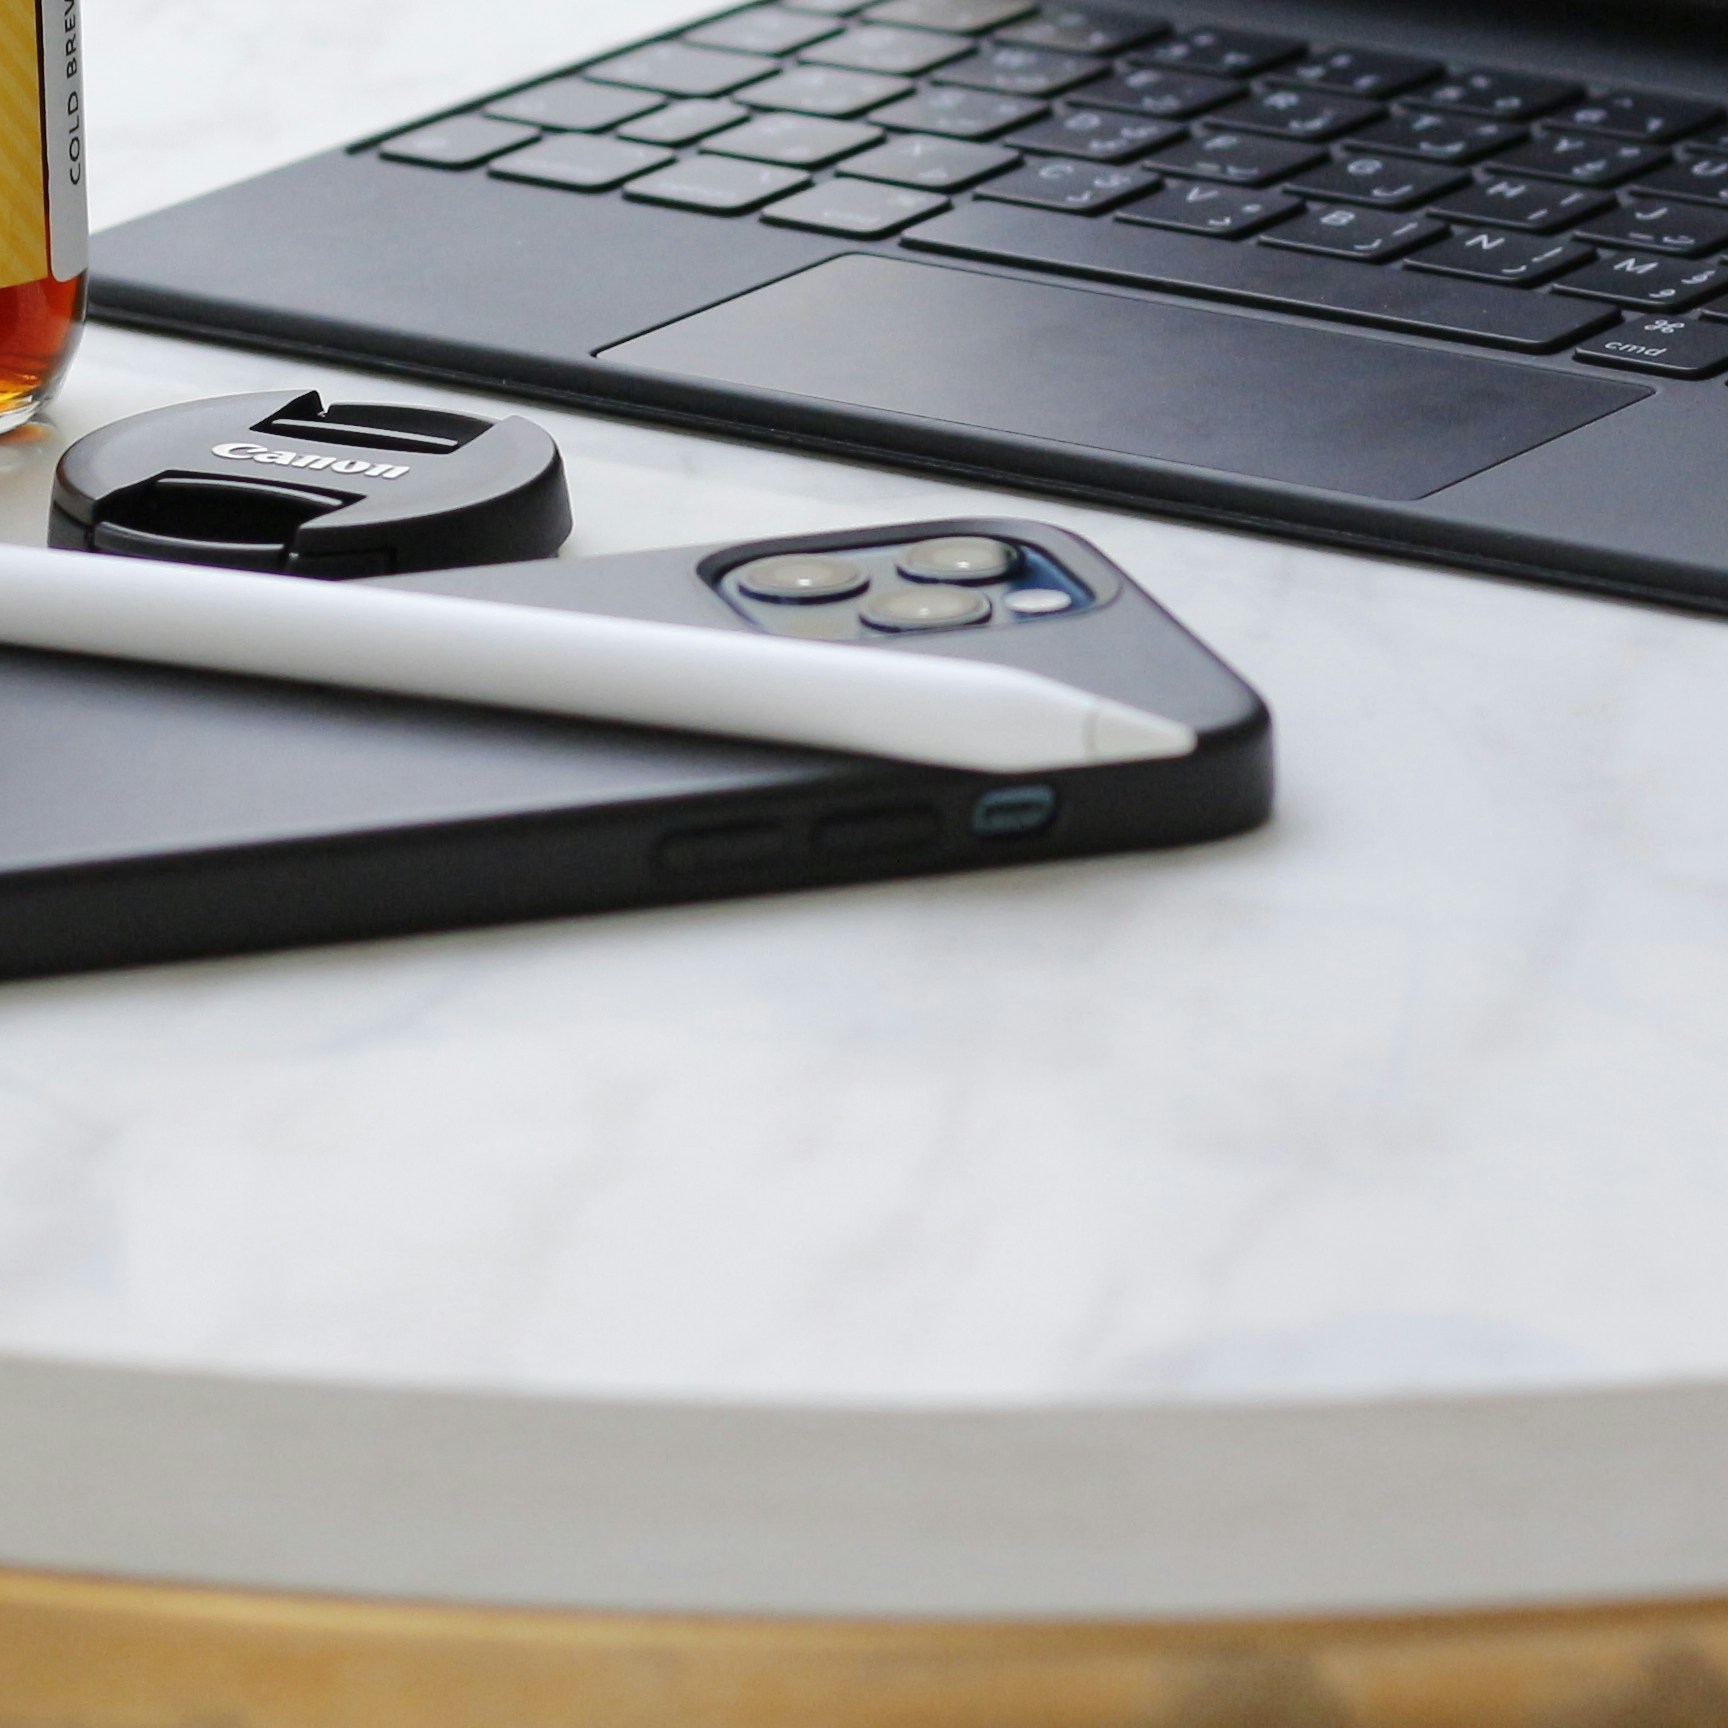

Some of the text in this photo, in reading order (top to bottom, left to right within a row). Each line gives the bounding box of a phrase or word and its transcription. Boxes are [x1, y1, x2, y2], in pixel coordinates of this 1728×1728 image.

[68, 90, 81, 186] COLD
[1486, 180, 1527, 198] H
[1465, 233, 1506, 250] N
[1613, 257, 1660, 274] M
[1604, 340, 1668, 359] cmd
[211, 442, 411, 479] Canon
